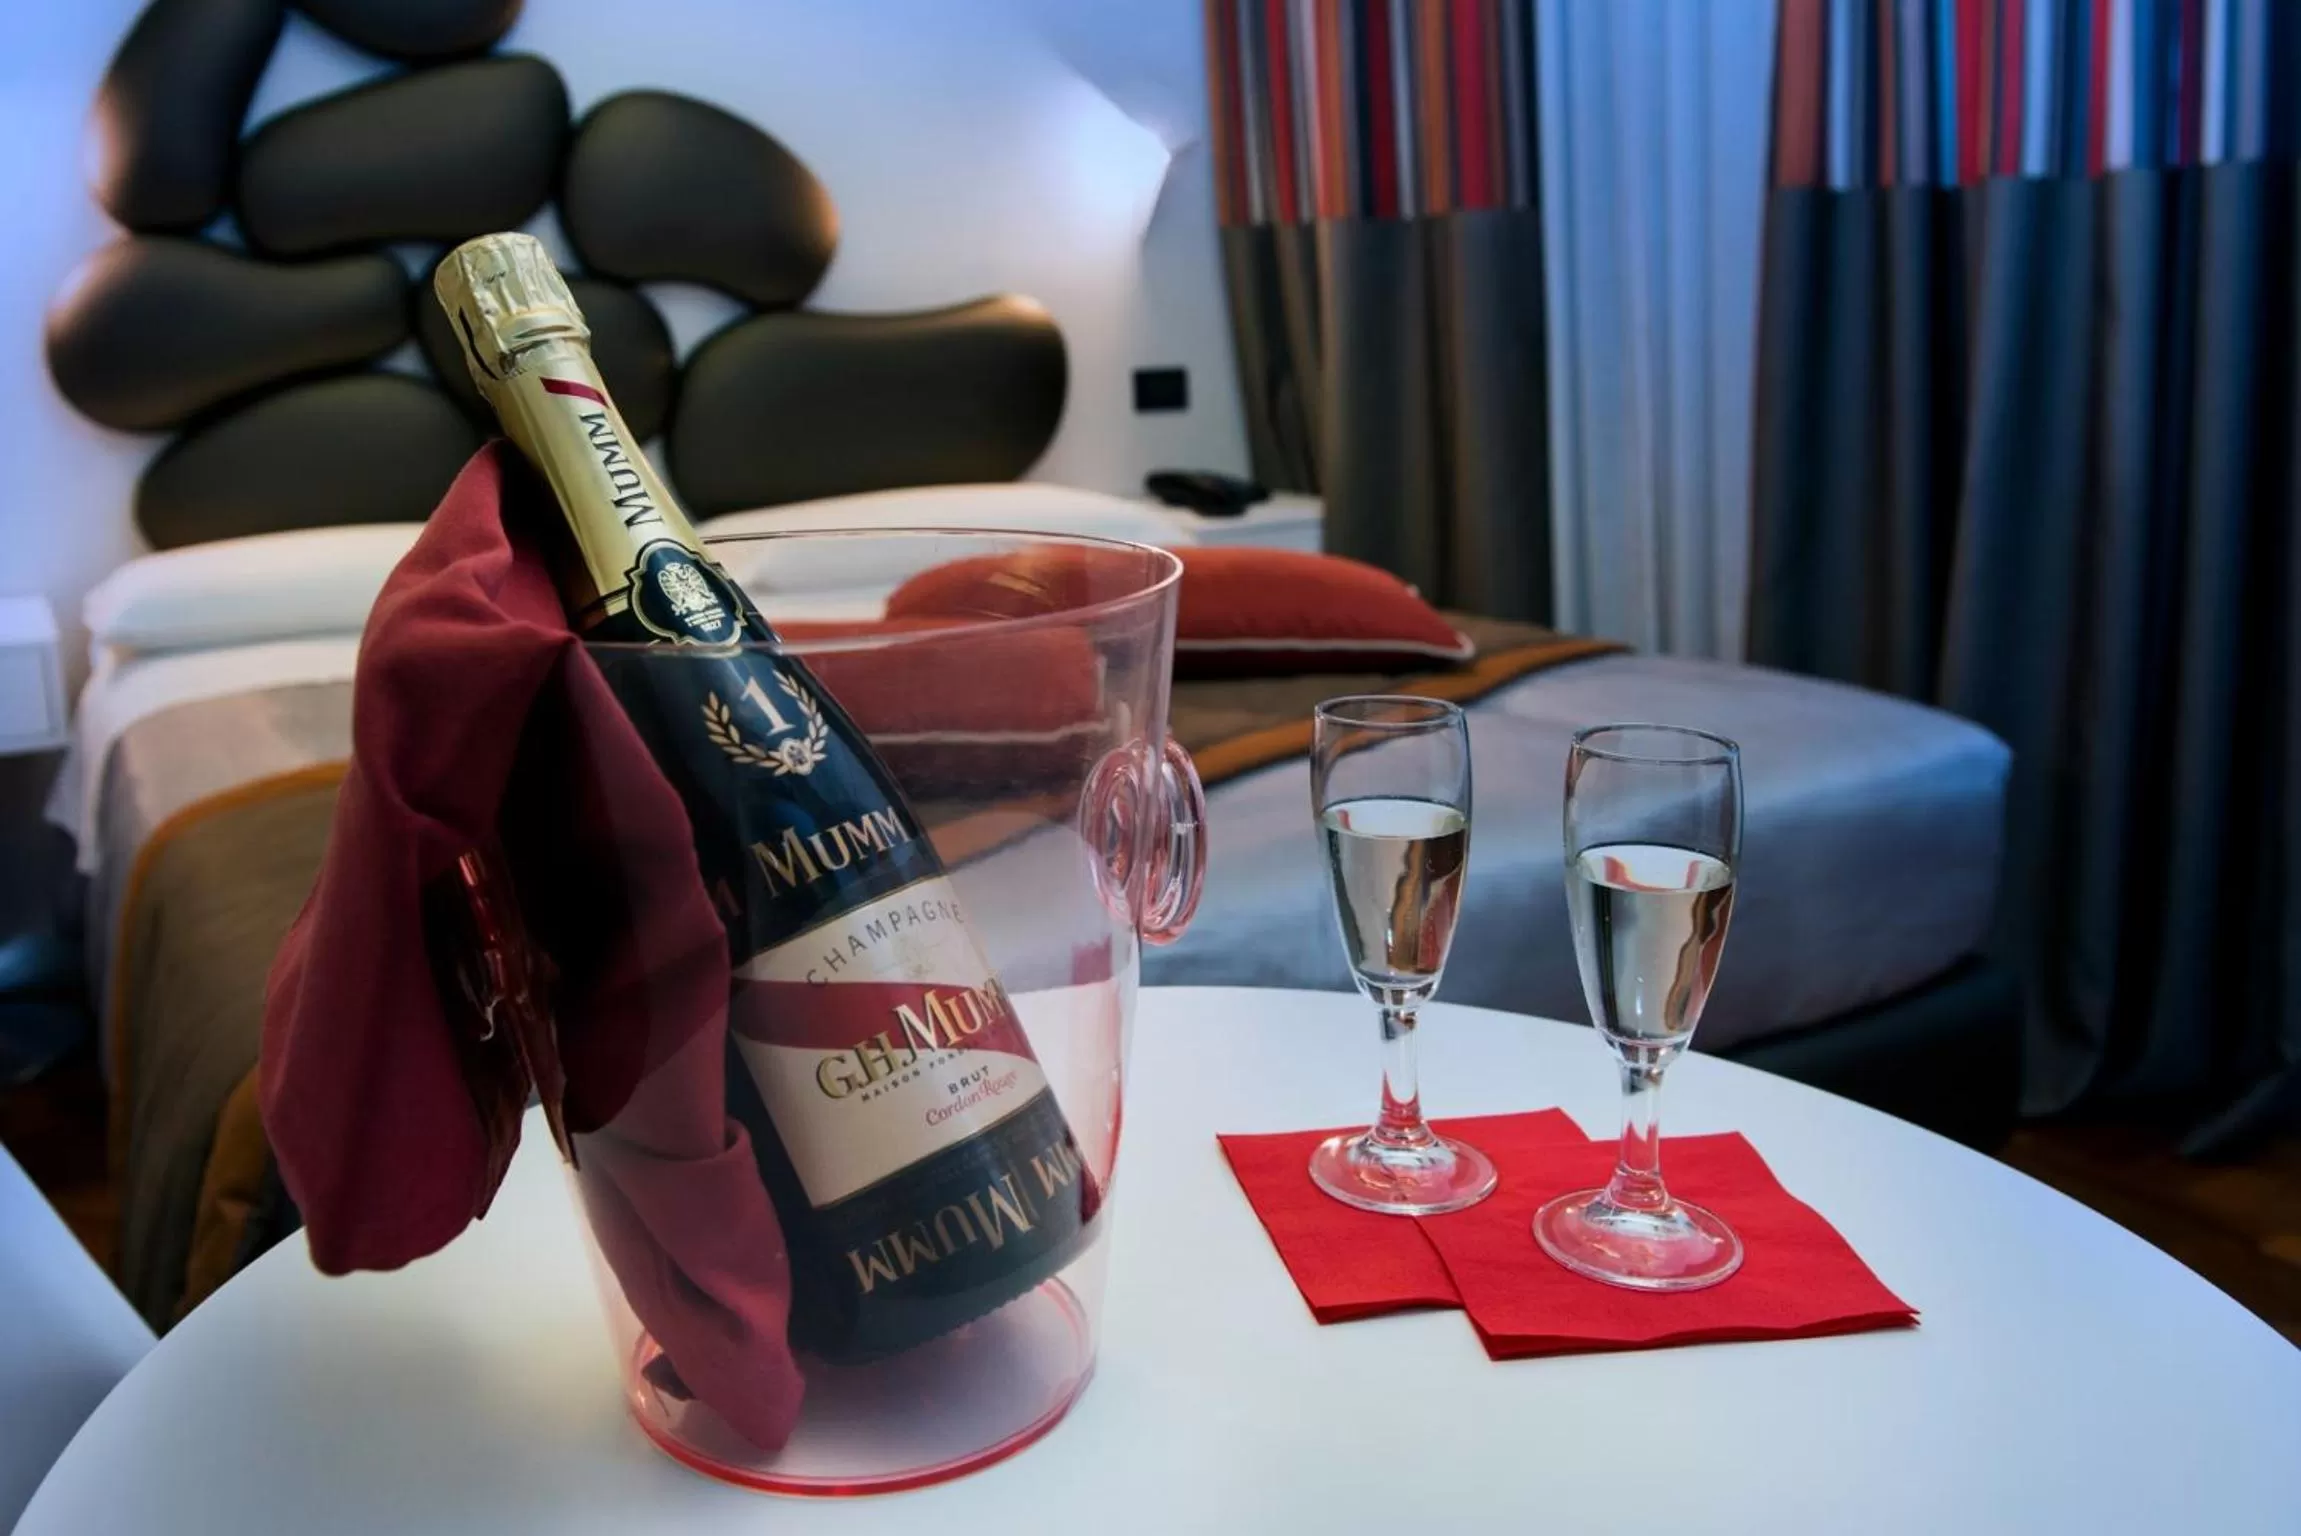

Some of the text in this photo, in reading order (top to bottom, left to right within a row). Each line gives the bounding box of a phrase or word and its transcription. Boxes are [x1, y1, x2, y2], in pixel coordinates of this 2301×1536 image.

[740, 676, 797, 738] 1
[807, 900, 965, 988] CHAMPAGNE
[861, 1069, 921, 1102] MAISON
[947, 1065, 990, 1096] BRUT
